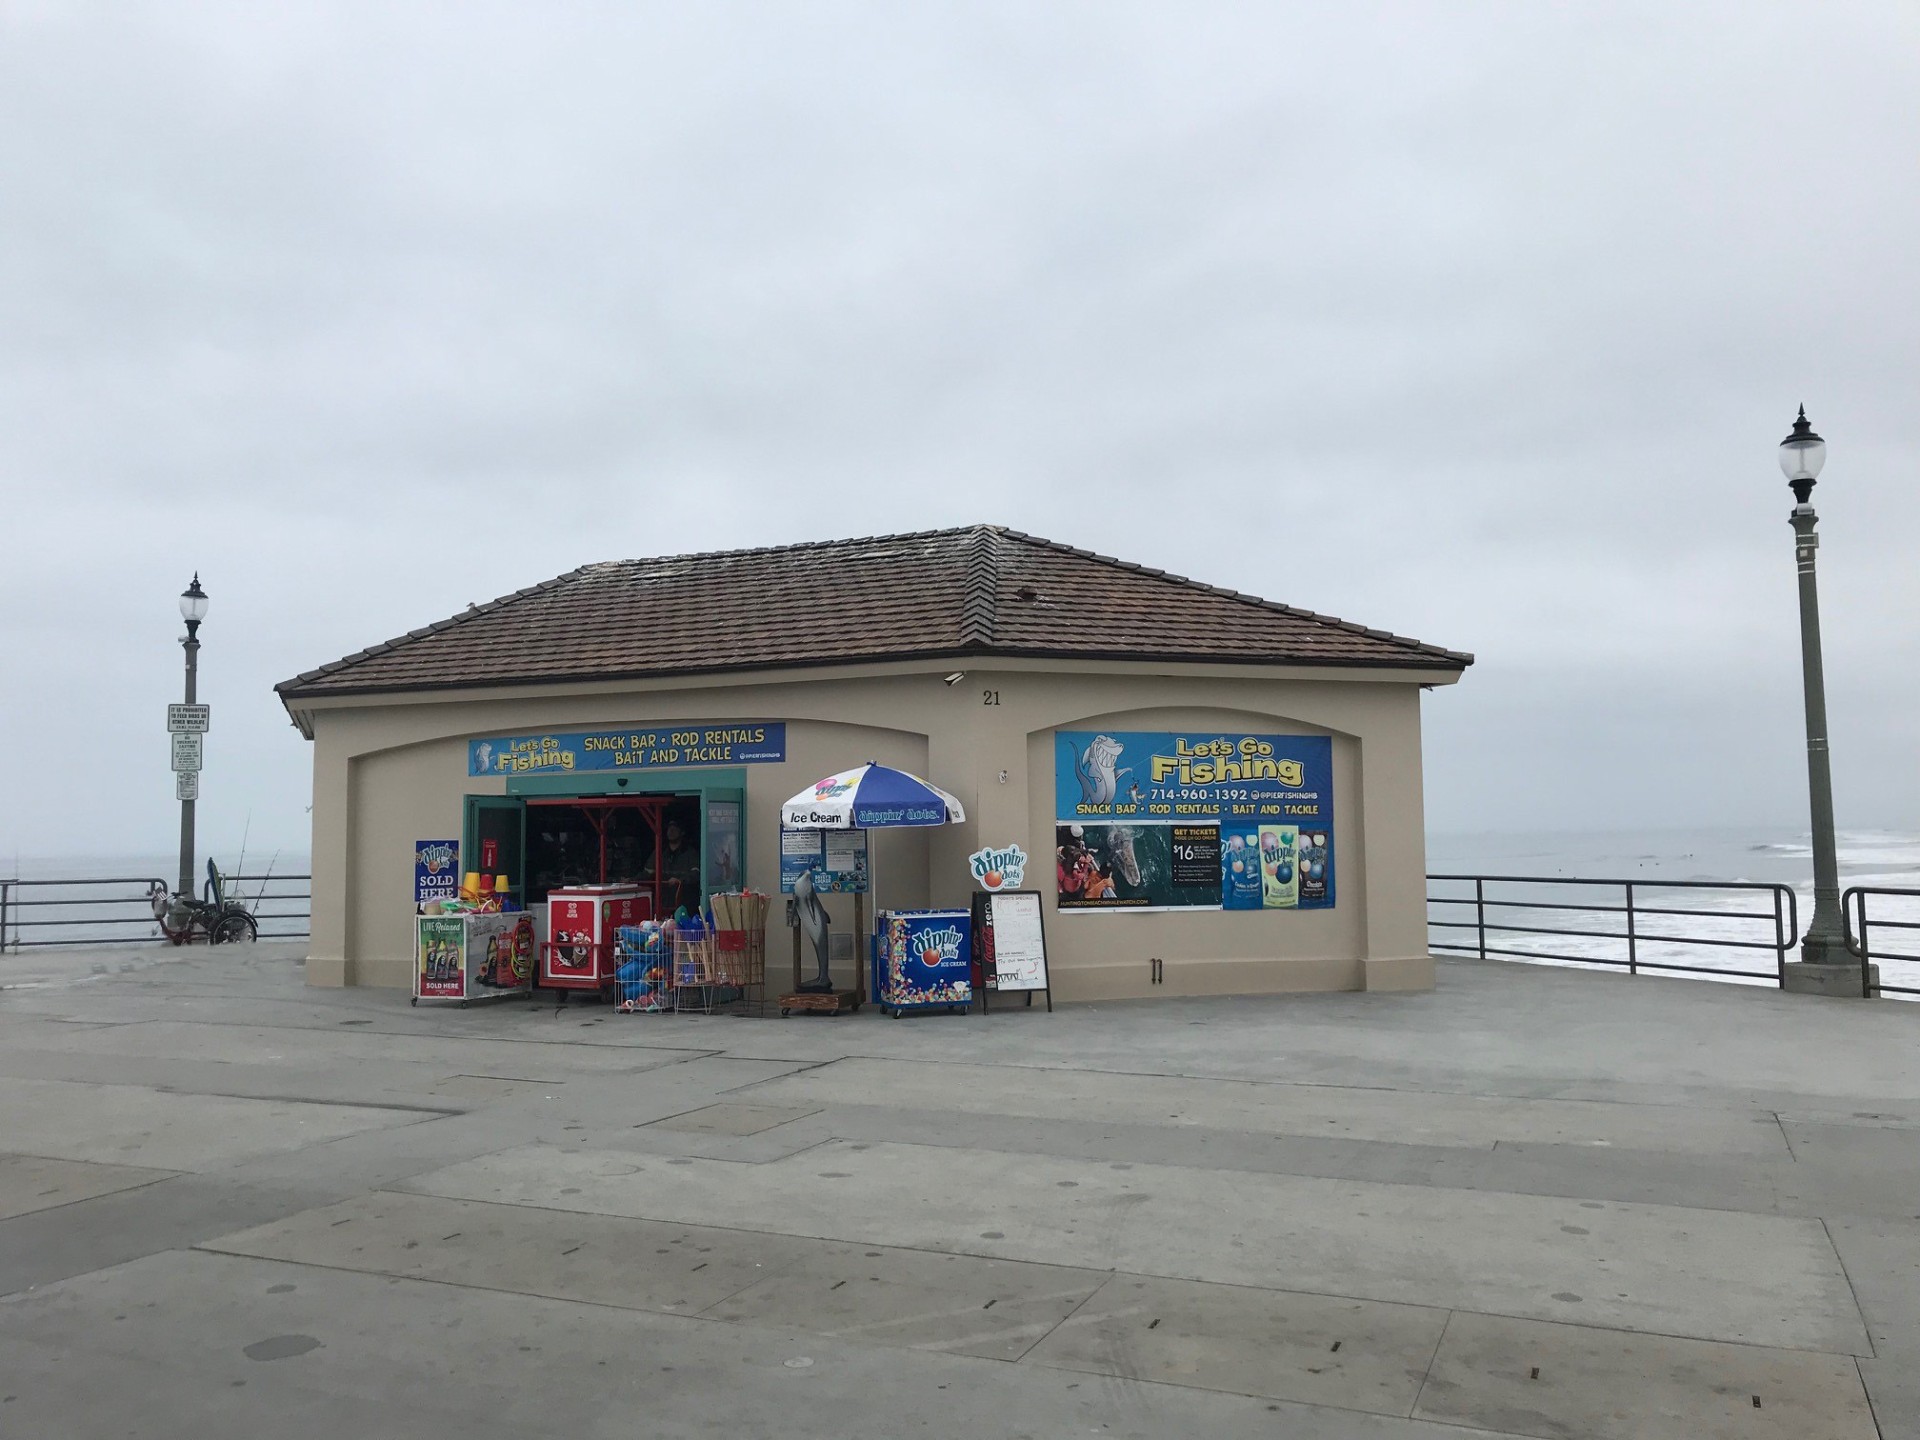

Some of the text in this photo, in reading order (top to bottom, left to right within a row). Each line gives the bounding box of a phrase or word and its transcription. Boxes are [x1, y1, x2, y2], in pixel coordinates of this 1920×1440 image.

[984, 690, 1000, 705] 21
[511, 736, 559, 752] Let's Go
[584, 729, 765, 750] SNACK BAR ROD RENTALS
[1176, 737, 1273, 757] Let's Go
[498, 749, 576, 771] Fishing
[650, 749, 679, 763] AND
[684, 747, 731, 761] TACKLE
[1152, 754, 1304, 788] Fishing
[1151, 789, 1248, 800] 714-960-1392
[859, 809, 904, 824] dippin'
[1076, 804, 1111, 814] SNACK
[1116, 804, 1136, 814] BAR
[1150, 804, 1171, 814] ROD
[1176, 804, 1220, 814] RENTALS
[1260, 805, 1280, 814] AND
[1285, 805, 1318, 814] TACKLE
[790, 811, 842, 823] Ice Cream
[1174, 845, 1194, 860] $16
[973, 848, 1024, 876] dippin'
[420, 876, 454, 886] SOLD
[1002, 870, 1020, 880] dots
[420, 888, 454, 899] HERE
[424, 922, 435, 931] LIVE
[913, 925, 963, 955] dippin'
[940, 949, 958, 958] dots
